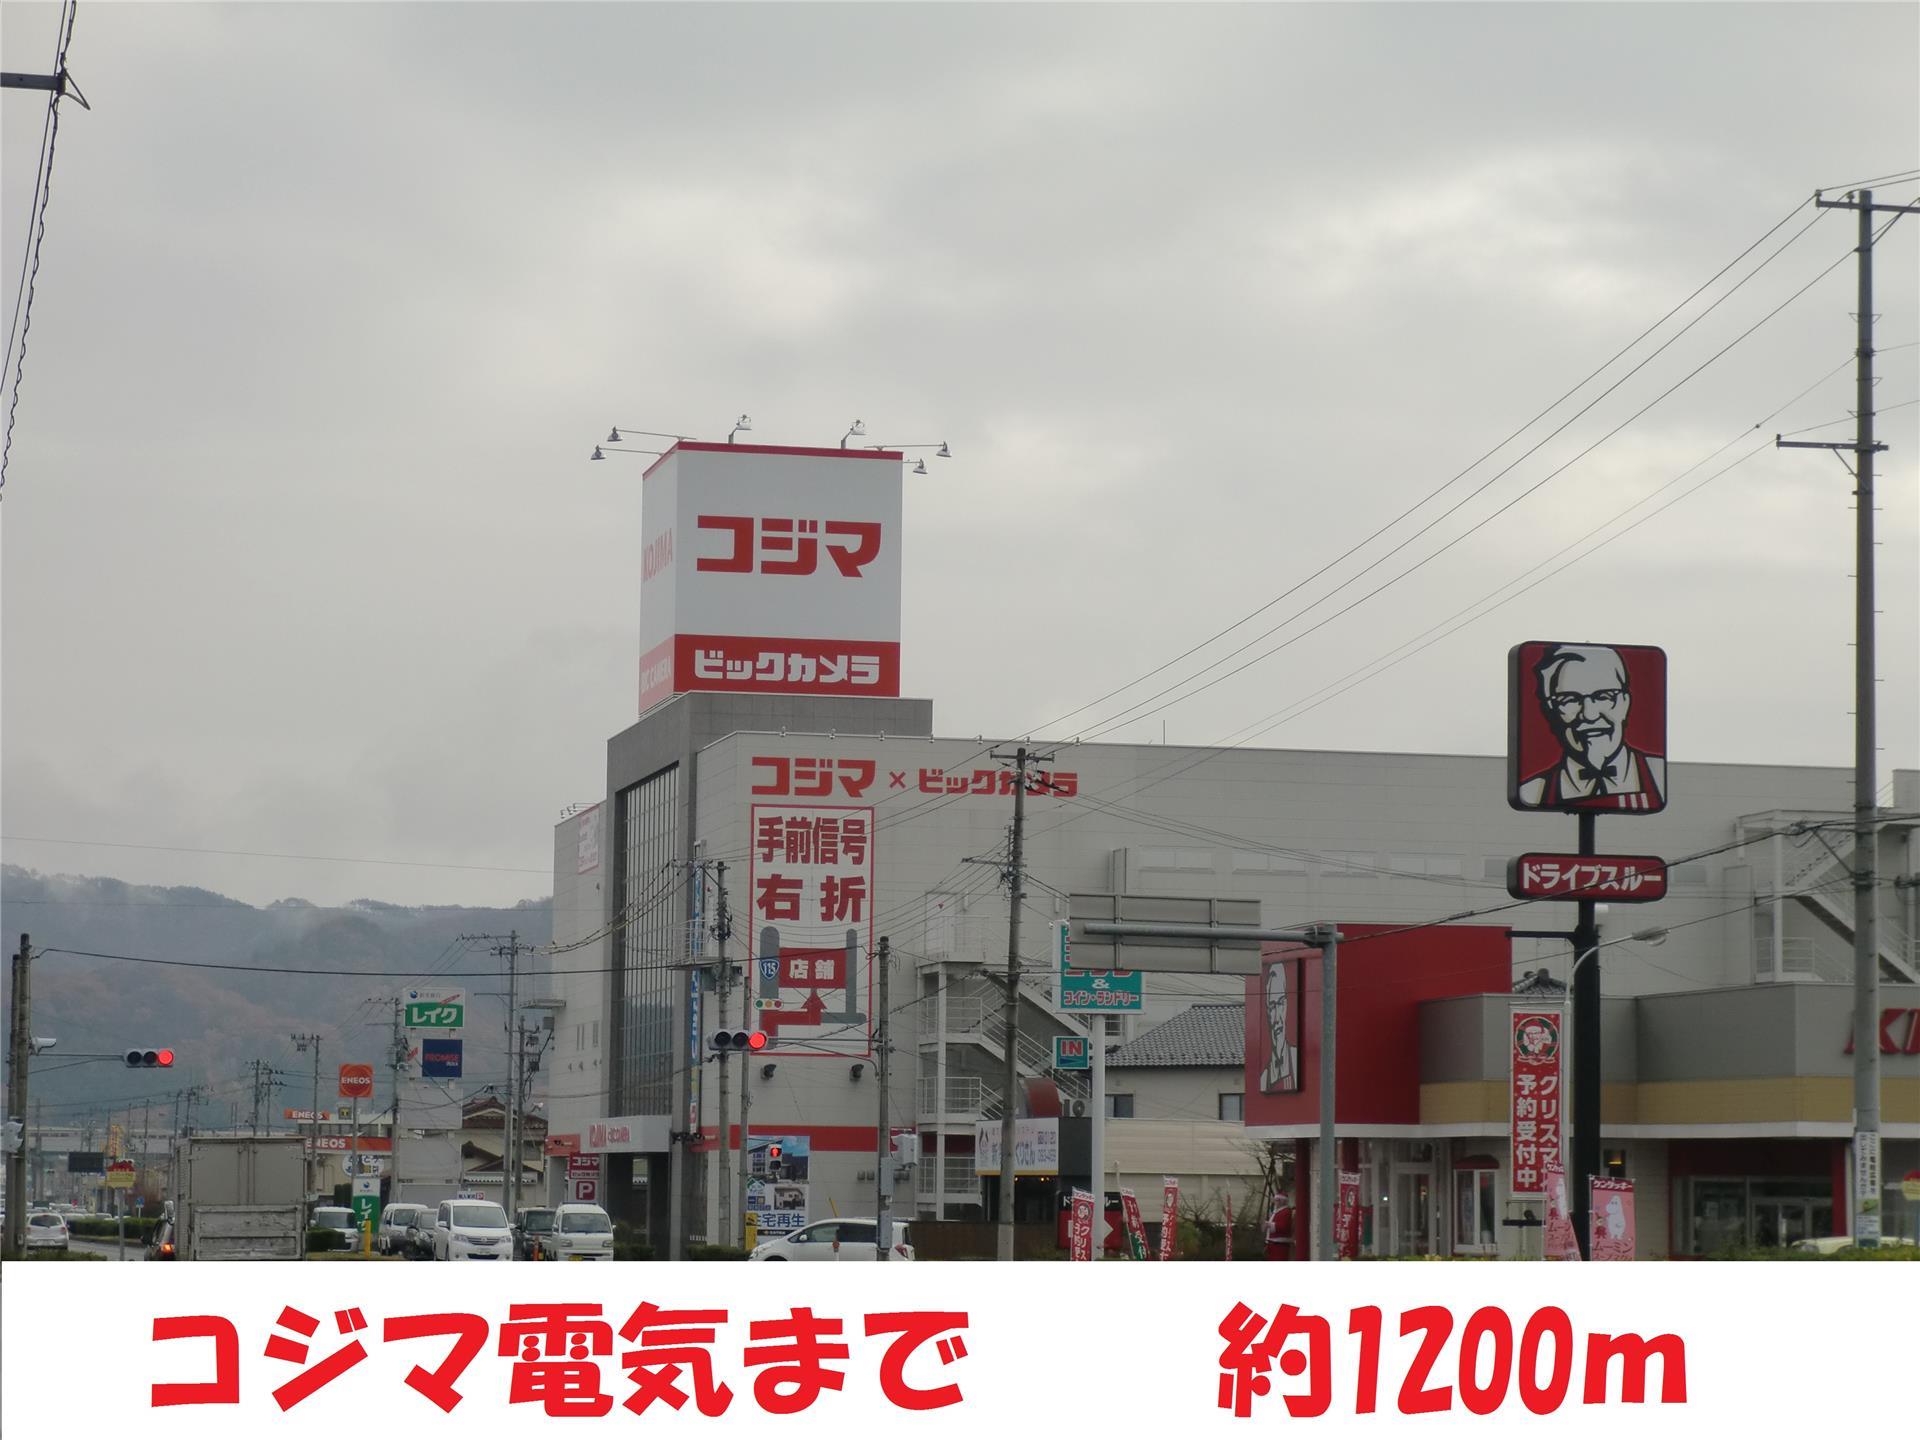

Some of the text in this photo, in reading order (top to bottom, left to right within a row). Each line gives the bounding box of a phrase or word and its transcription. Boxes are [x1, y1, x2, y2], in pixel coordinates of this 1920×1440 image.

[696, 515, 881, 578] コジマ
[694, 649, 880, 684] ビックカメラ
[751, 756, 876, 798] コジマ
[757, 816, 867, 866] 手前信号
[1521, 862, 1662, 891] ドライブスルー
[757, 874, 866, 922] 右折
[789, 959, 835, 979] 店舗
[411, 1007, 458, 1024] レイク
[1060, 1040, 1083, 1056] IN
[341, 1076, 371, 1085] ENEOS
[292, 1110, 324, 1119] ENEOS
[1516, 1074, 1538, 1188] 予約受付中
[572, 1156, 600, 1167] コジマ
[578, 1183, 593, 1198] P
[1592, 1181, 1633, 1190] ケンタッキー
